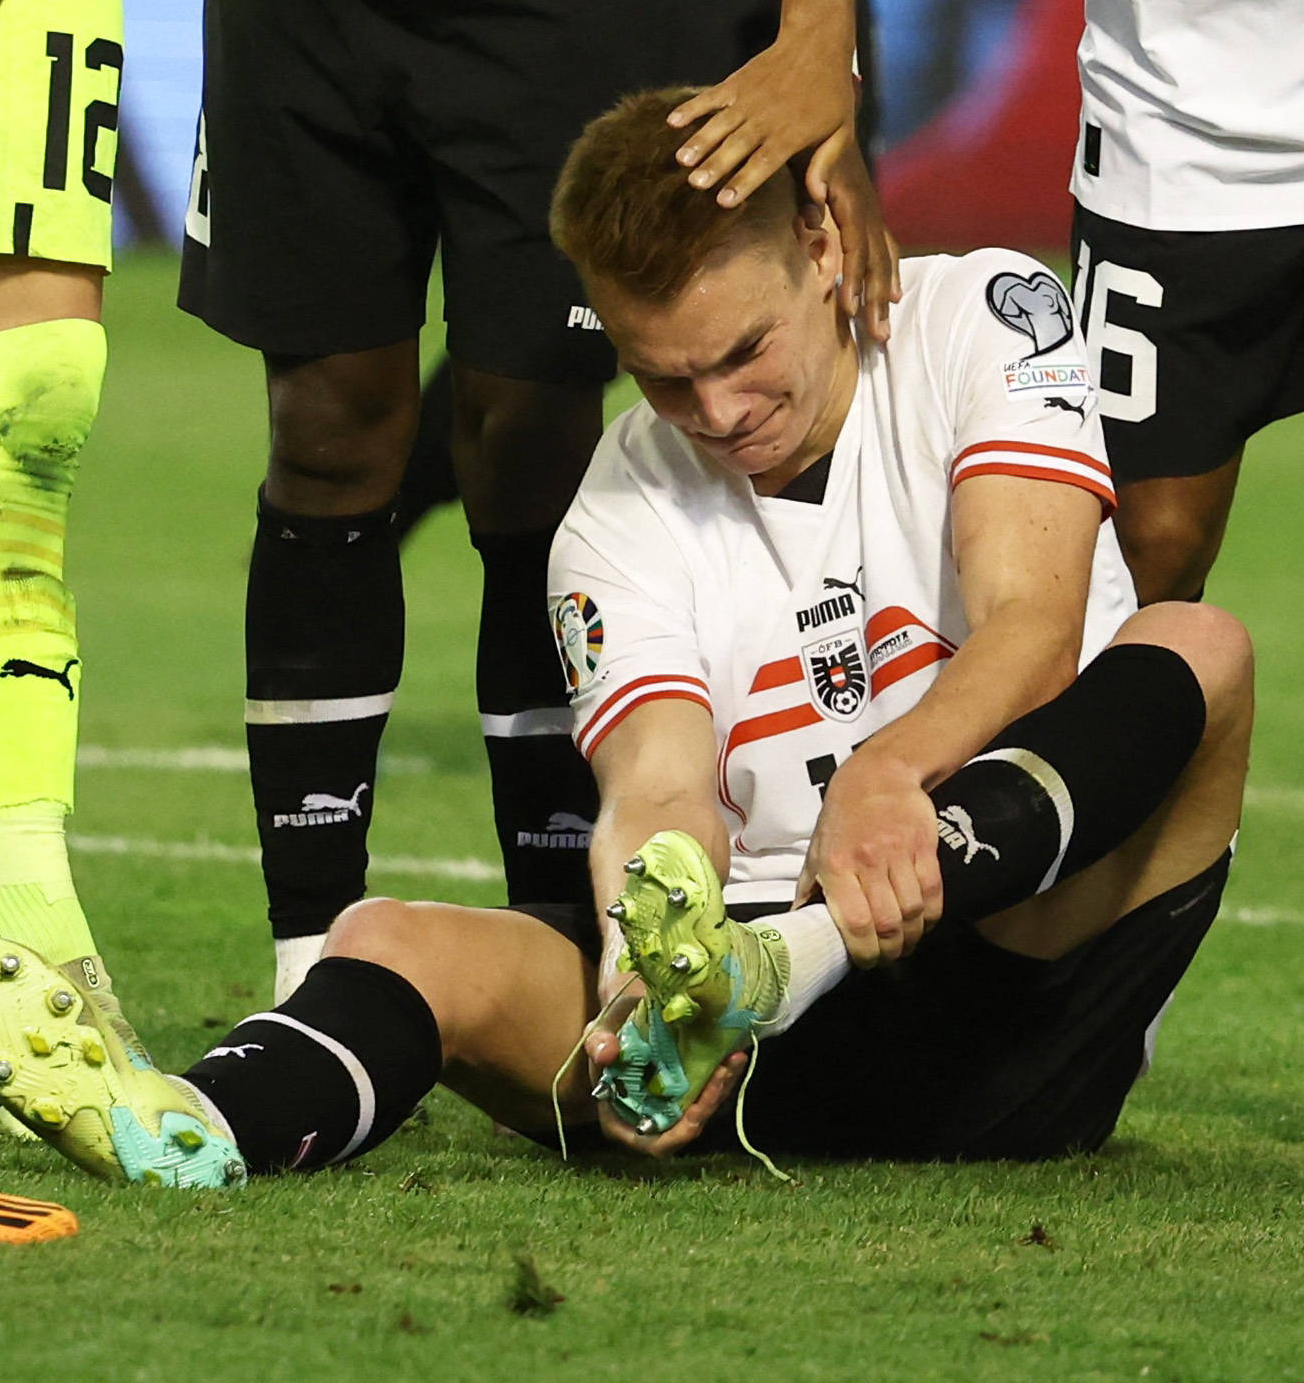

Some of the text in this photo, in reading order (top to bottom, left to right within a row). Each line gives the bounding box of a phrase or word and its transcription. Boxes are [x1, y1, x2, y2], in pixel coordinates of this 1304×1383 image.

[42, 30, 124, 204] 12
[567, 305, 605, 331] PU
[1005, 369, 1088, 388] FOUNDAT
[796, 593, 855, 632] PUMA
[273, 809, 349, 828] PUMA
[517, 831, 593, 849] PUMA
